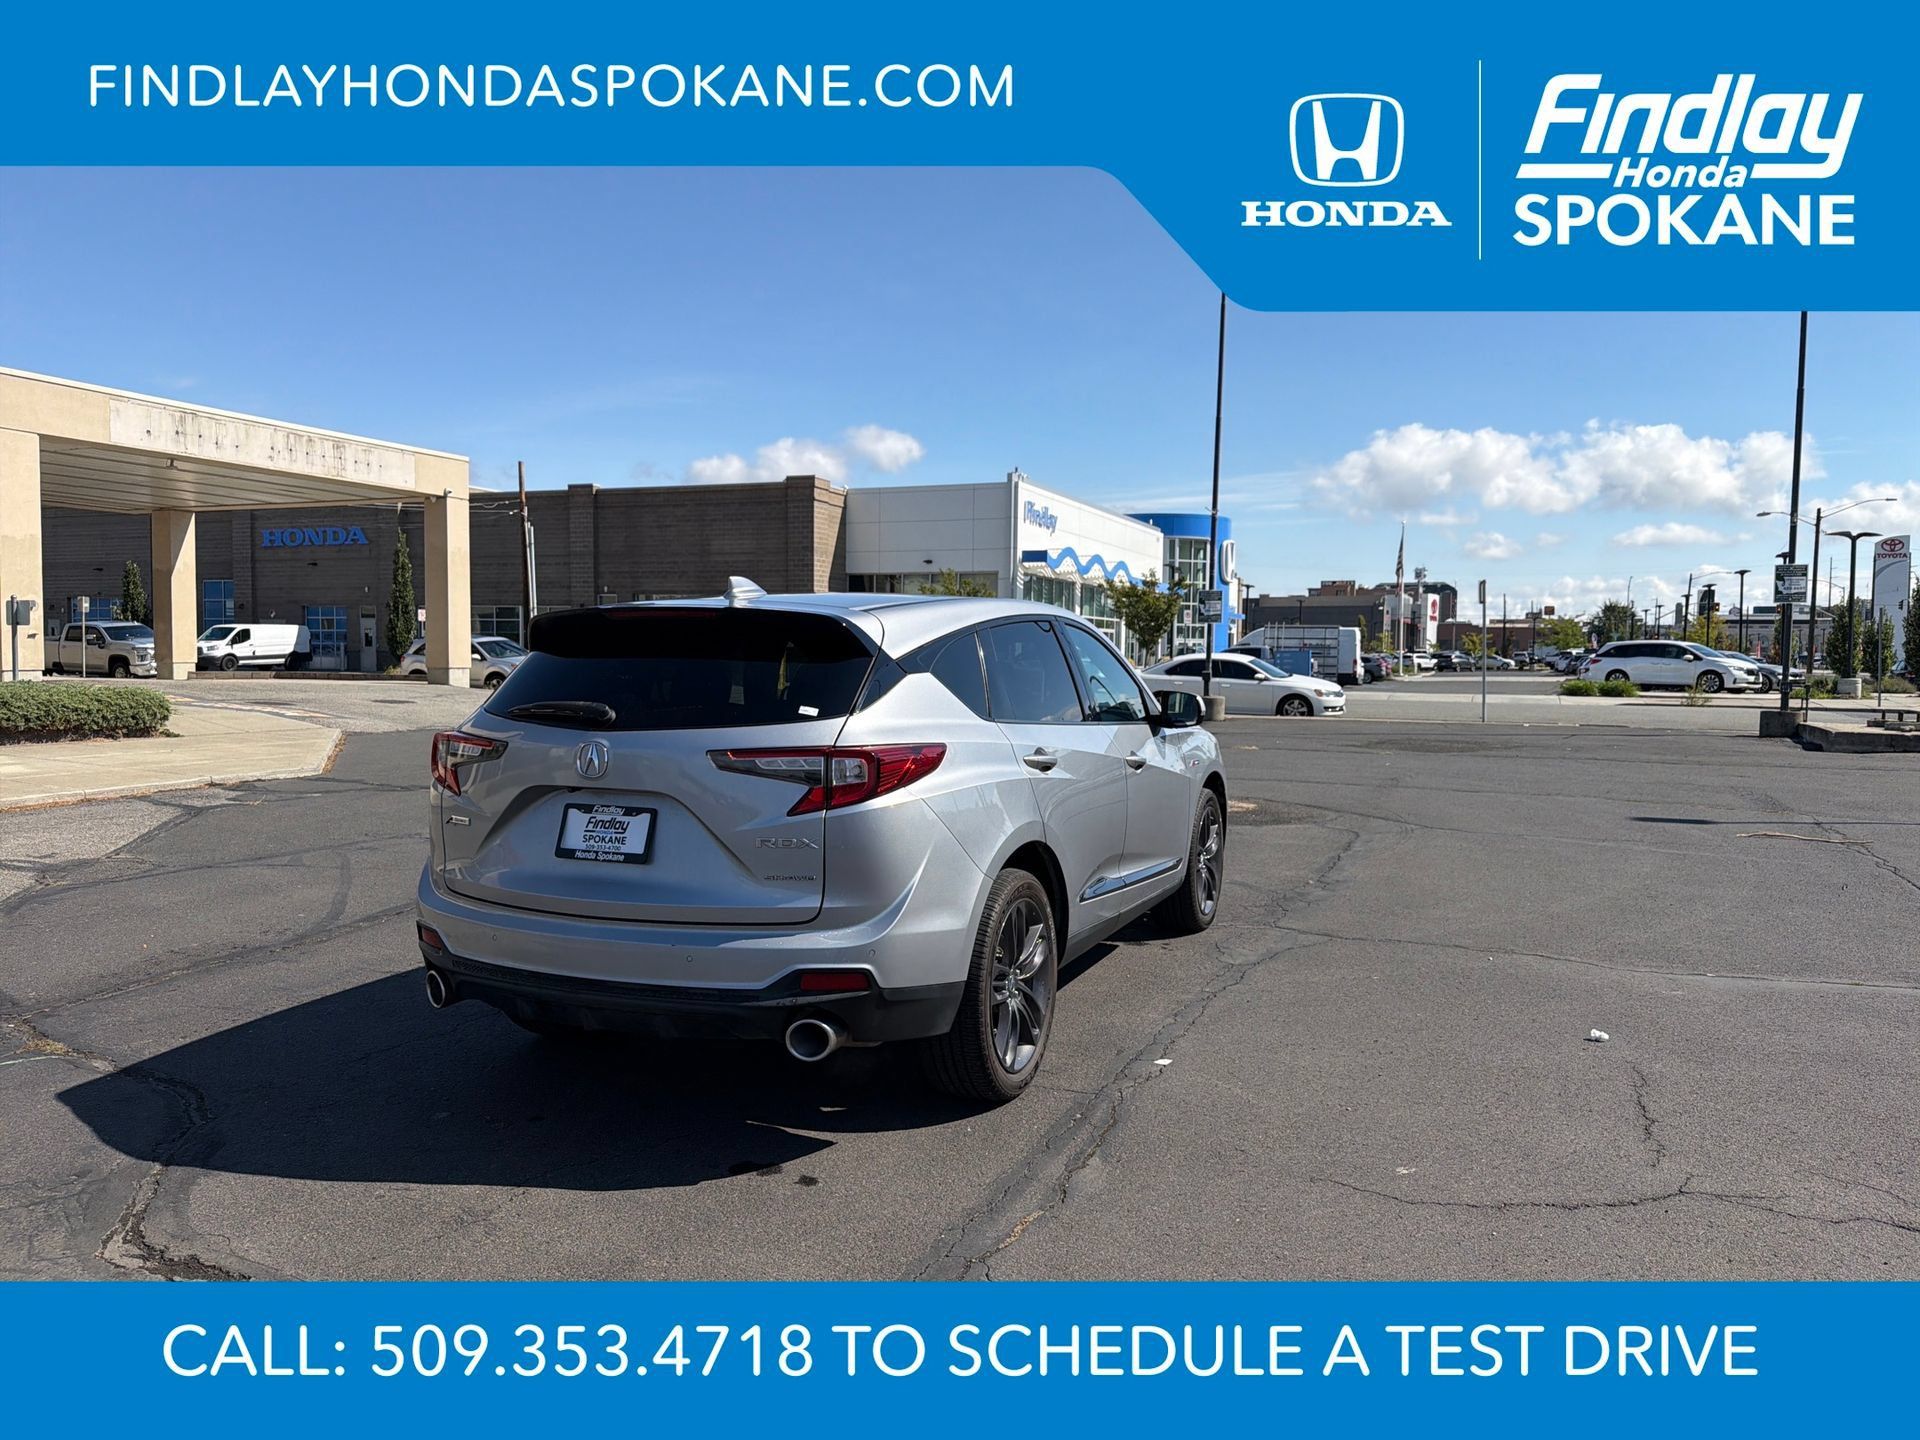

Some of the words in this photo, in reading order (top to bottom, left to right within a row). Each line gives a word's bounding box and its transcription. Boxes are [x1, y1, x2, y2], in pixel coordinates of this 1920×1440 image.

[262, 525, 369, 547] HONDA
[592, 805, 626, 815] Findlay
[584, 816, 630, 834] Findlay
[582, 834, 627, 845] SPOKANE
[755, 837, 819, 849] RDX
[575, 850, 597, 860] Honda
[597, 852, 625, 862] Spokane
